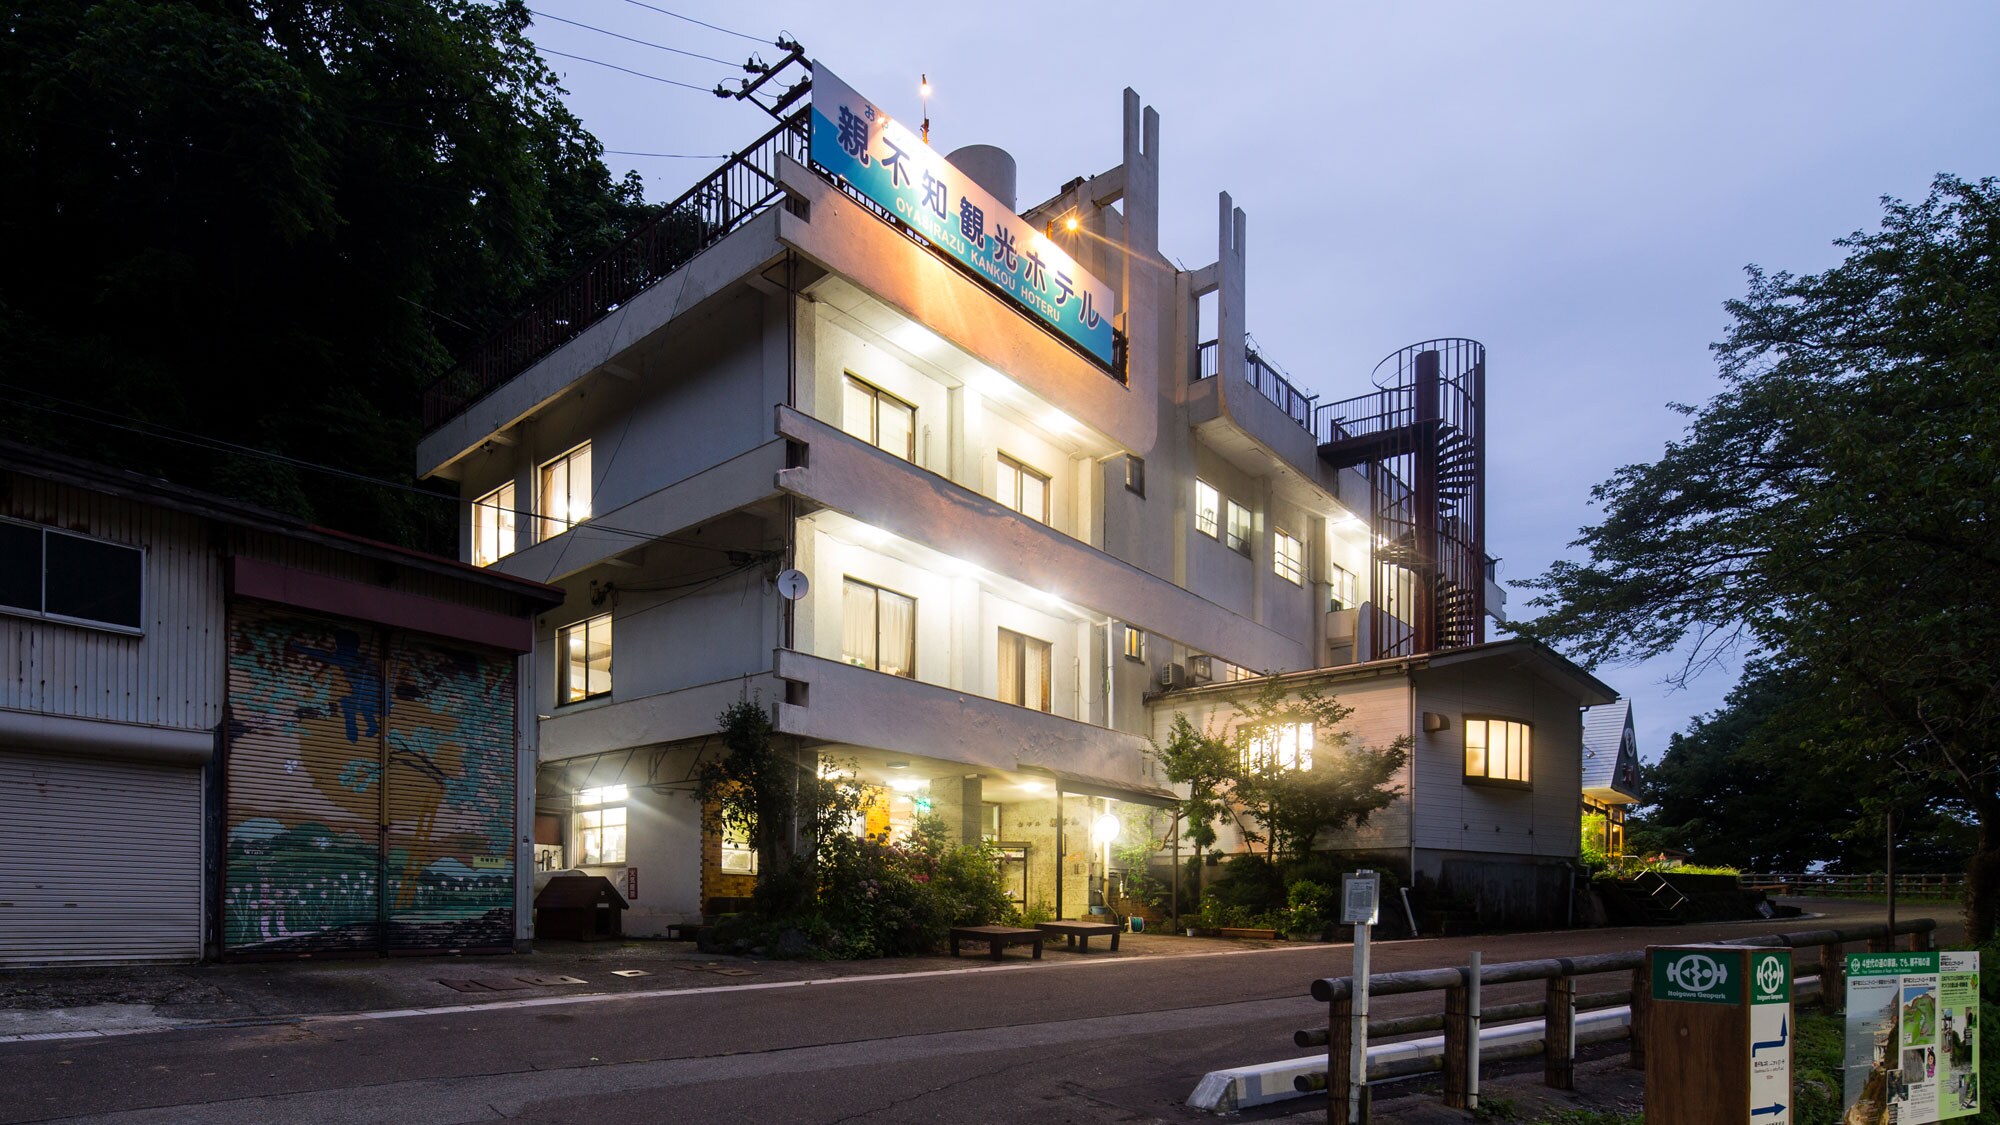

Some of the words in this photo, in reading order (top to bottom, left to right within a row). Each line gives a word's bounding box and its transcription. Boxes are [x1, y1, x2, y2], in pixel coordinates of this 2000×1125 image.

[837, 105, 1100, 329] 親不知観光ホテル
[895, 197, 965, 255] OYASIRAZU
[970, 249, 1016, 290] KANKOU
[1021, 285, 1060, 322] HOTERU
[1697, 991, 1726, 999] Geopark
